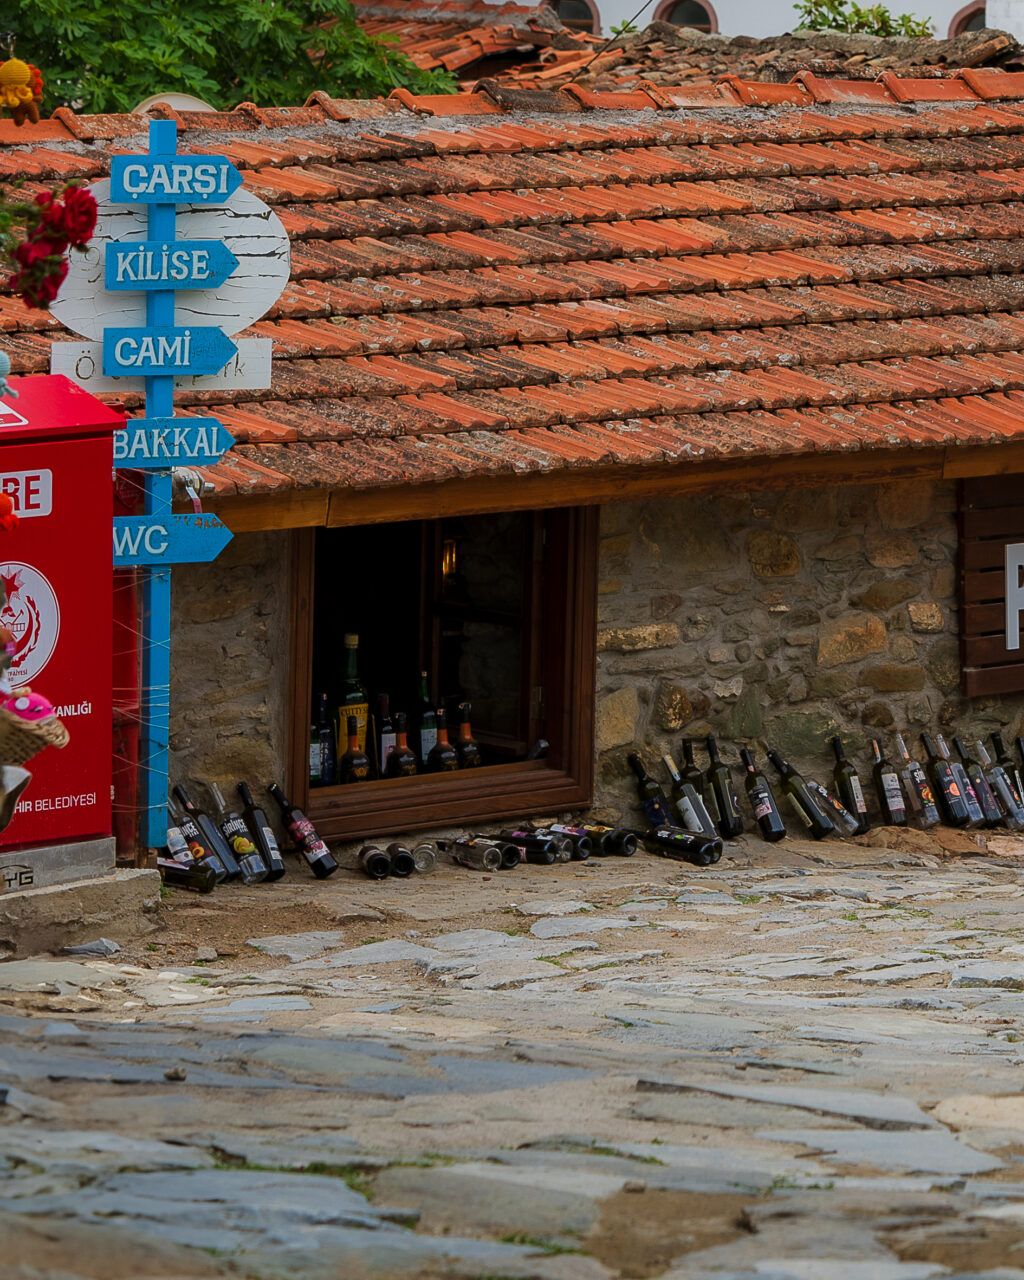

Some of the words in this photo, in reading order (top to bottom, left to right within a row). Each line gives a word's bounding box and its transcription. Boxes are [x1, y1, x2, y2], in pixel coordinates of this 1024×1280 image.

[123, 164, 229, 199] ÇARŞI
[116, 244, 210, 282] KİLİSE
[114, 330, 192, 366] CAMİ
[113, 427, 225, 458] BAKKAL
[113, 525, 168, 556] WC
[35, 792, 97, 812] BELEDİYESİ
